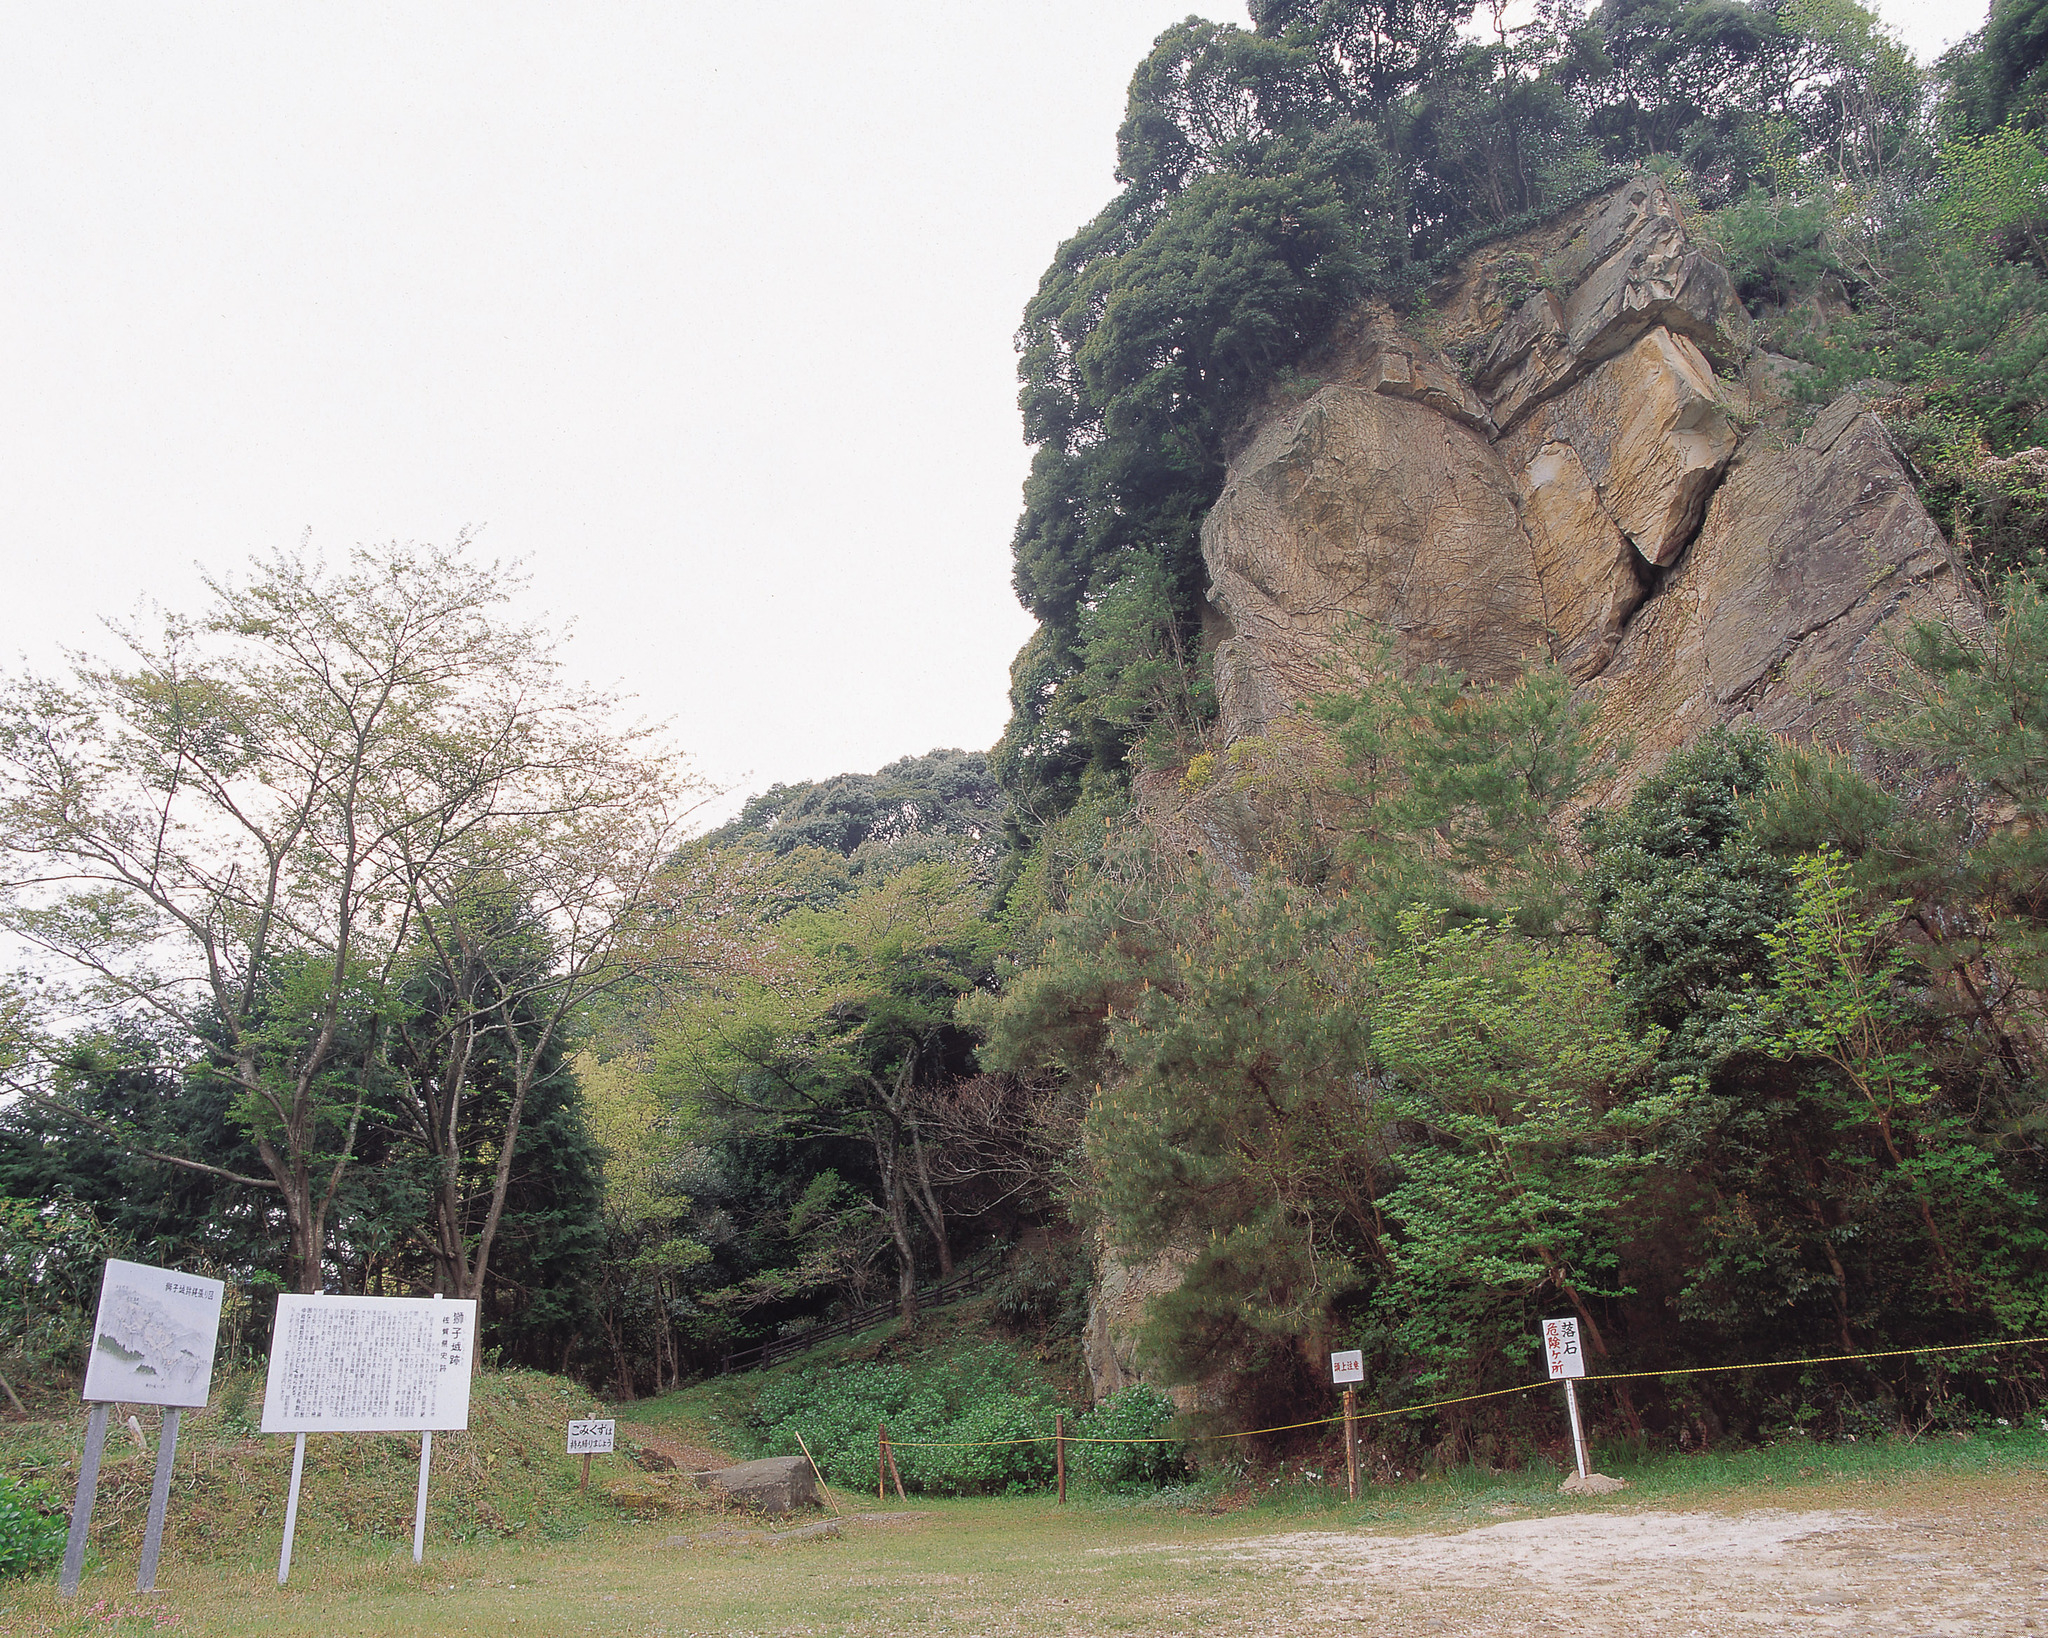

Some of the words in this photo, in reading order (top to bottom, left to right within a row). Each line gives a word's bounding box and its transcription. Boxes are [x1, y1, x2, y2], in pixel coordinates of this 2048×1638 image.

[1546, 1322, 1564, 1375] 危険ケ所
[1561, 1321, 1577, 1355] 落石
[571, 1424, 612, 1436] ごみくずは
[570, 1438, 612, 1449] 持ち帰りましょう
